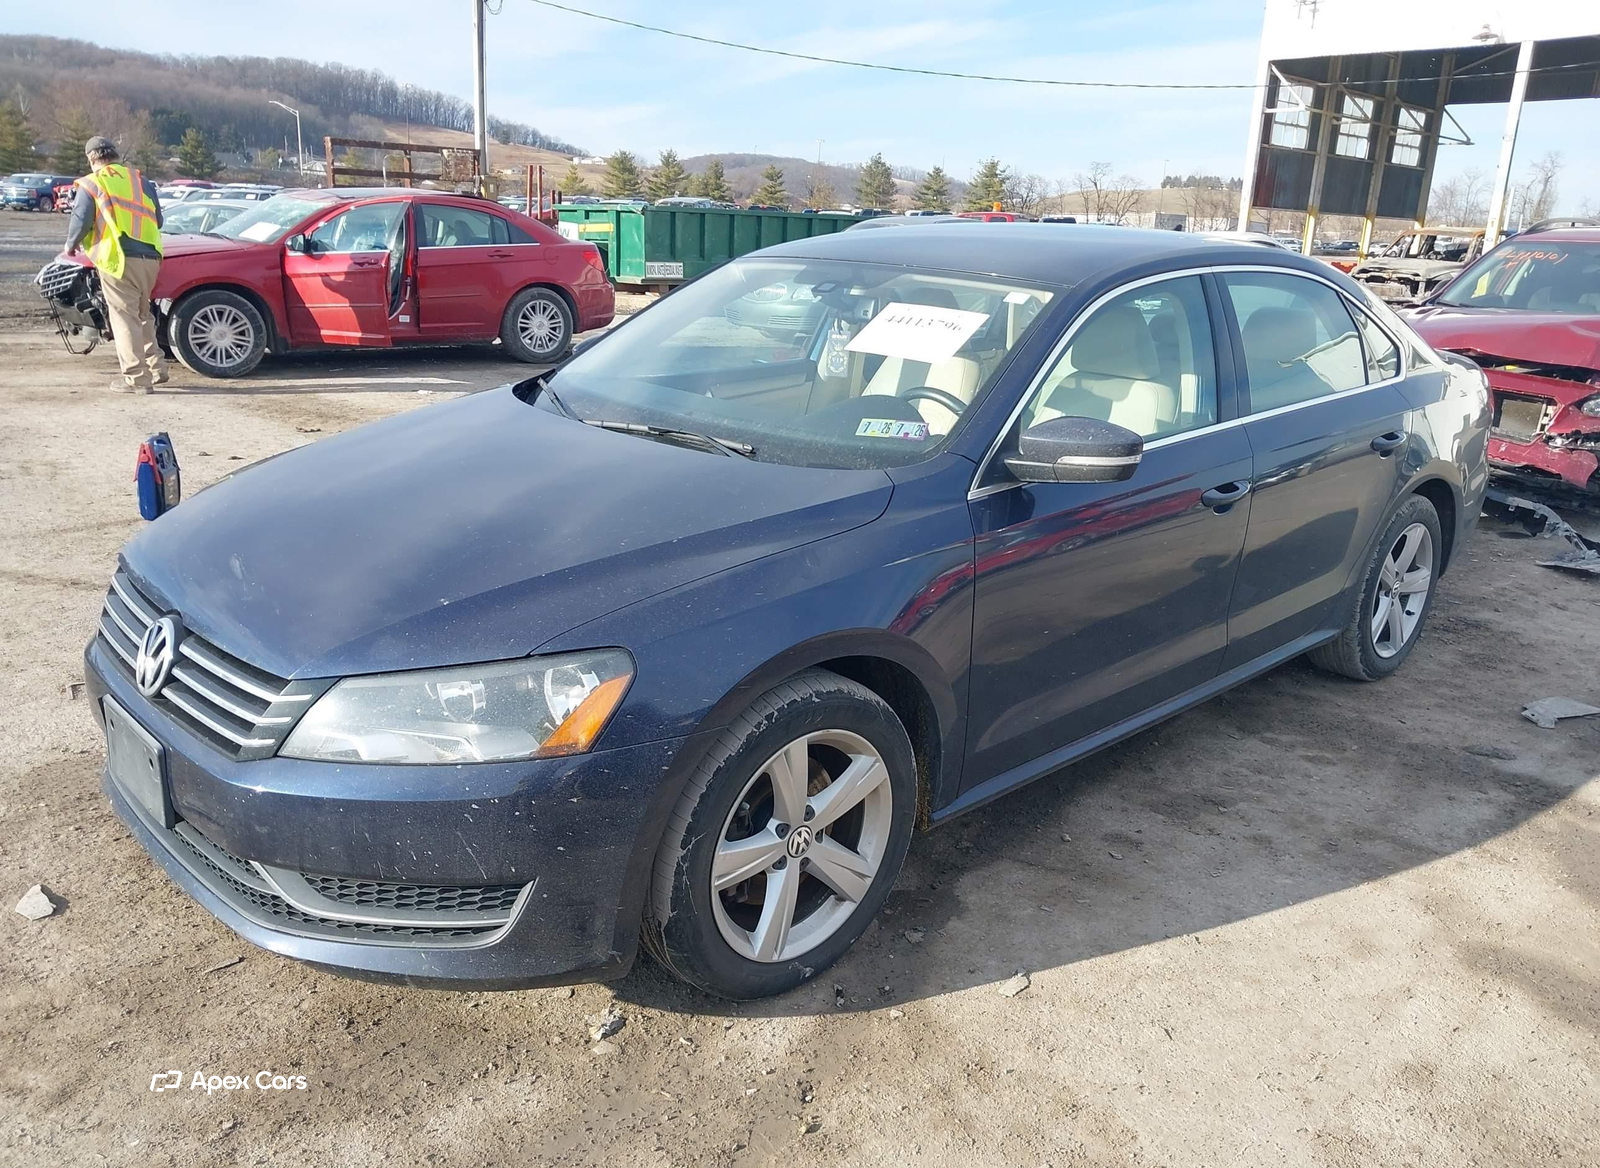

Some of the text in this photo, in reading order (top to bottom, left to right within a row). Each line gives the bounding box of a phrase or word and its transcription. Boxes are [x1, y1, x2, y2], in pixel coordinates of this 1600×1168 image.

[863, 421, 872, 433] 7
[895, 423, 926, 437] 7 26
